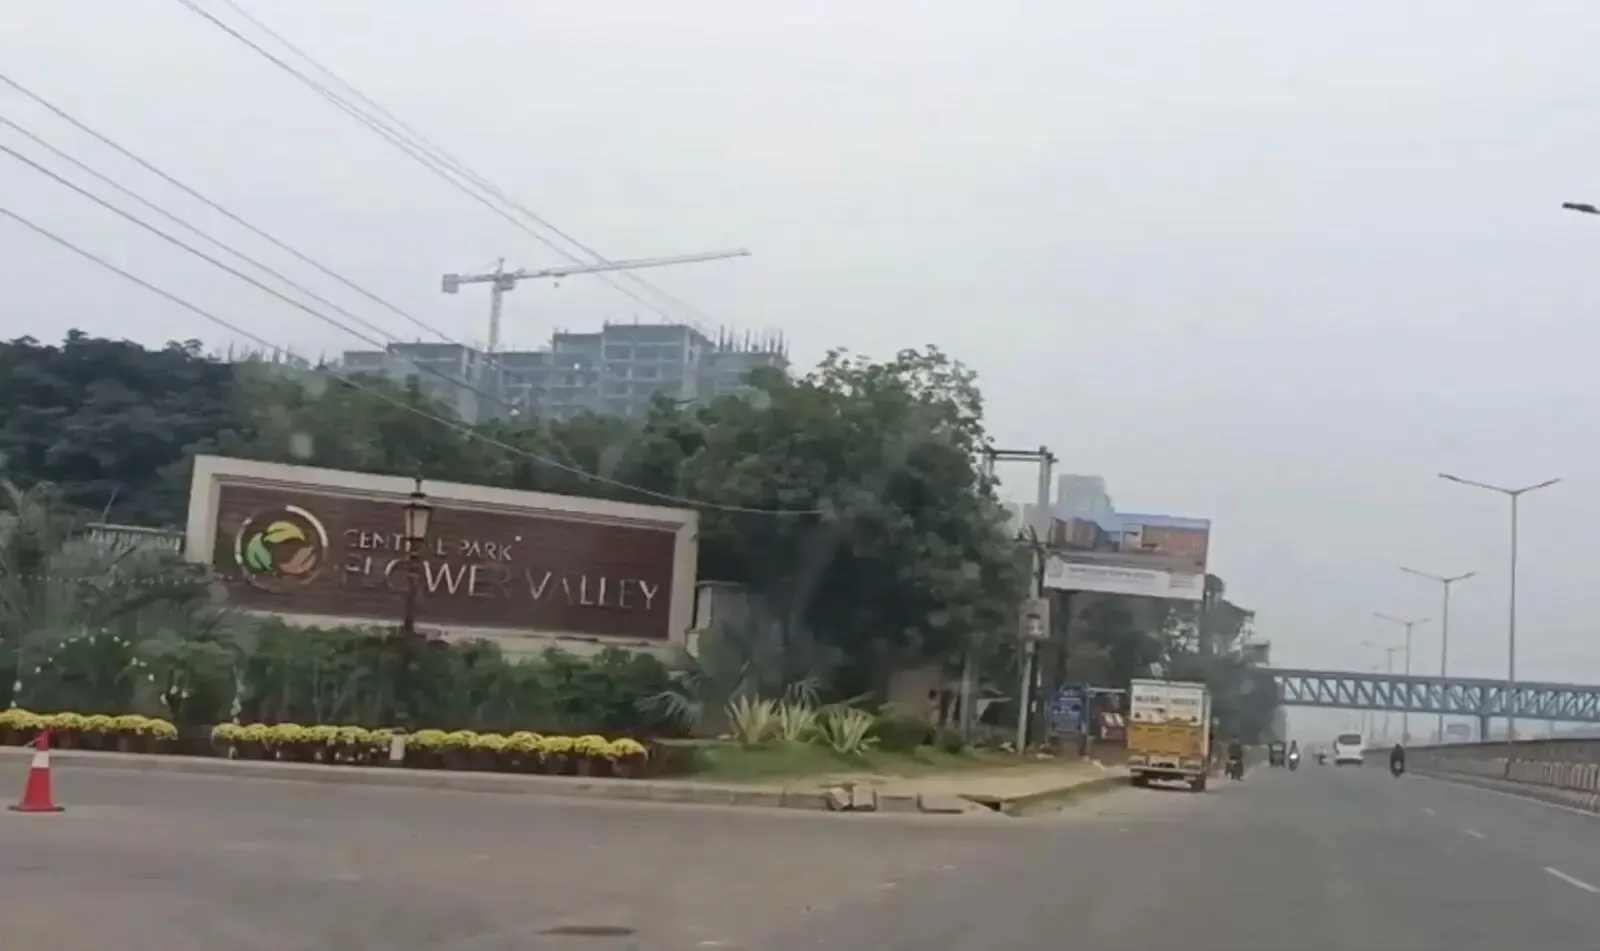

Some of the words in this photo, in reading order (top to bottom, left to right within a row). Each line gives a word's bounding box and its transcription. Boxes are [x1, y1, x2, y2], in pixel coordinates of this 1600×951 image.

[343, 529, 448, 556] CENTL
[459, 539, 513, 562] PARK
[524, 567, 660, 610] VALLEY
